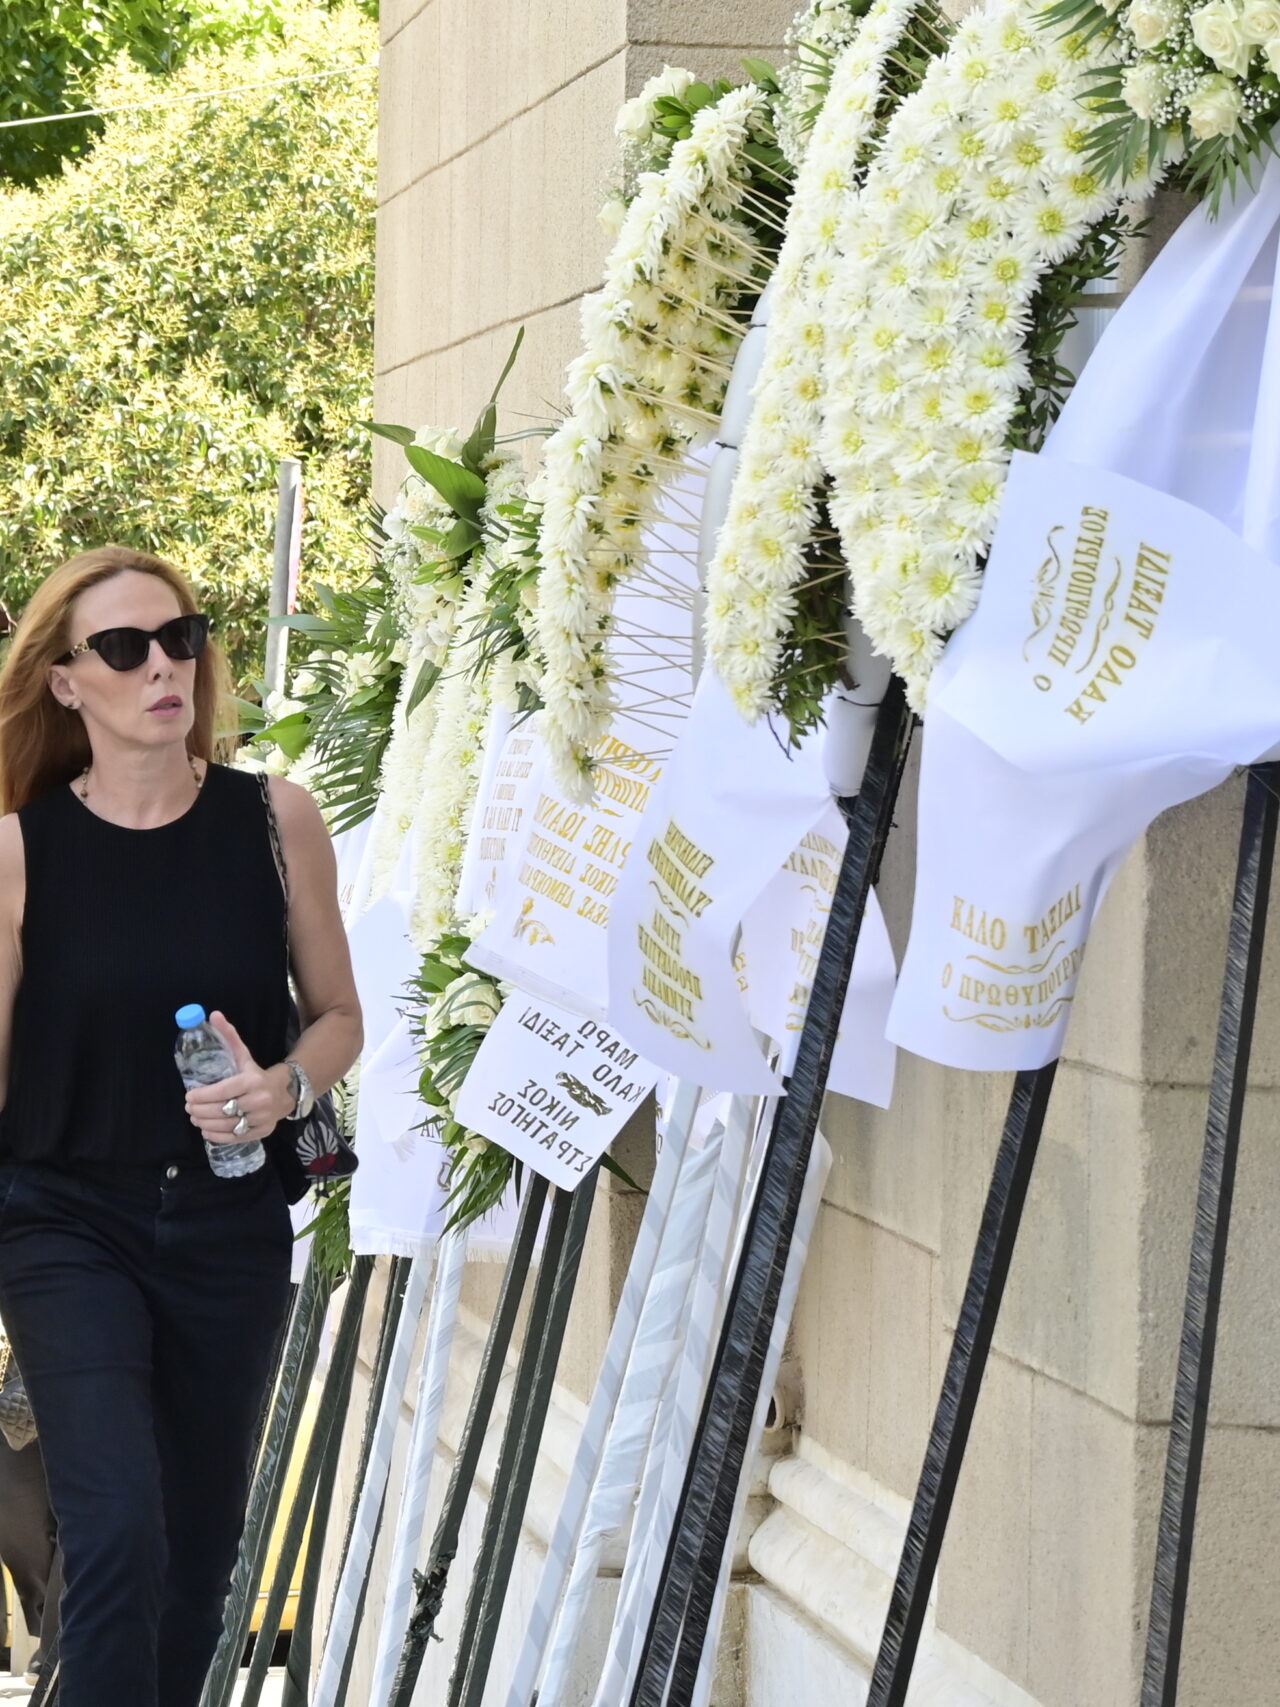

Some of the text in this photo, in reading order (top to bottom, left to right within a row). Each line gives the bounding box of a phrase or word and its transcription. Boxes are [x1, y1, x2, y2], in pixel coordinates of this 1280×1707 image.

[950, 882, 1081, 954] ΚΑΛΟ ΤΑΞΙΔΙ
[941, 962, 953, 988] Ο
